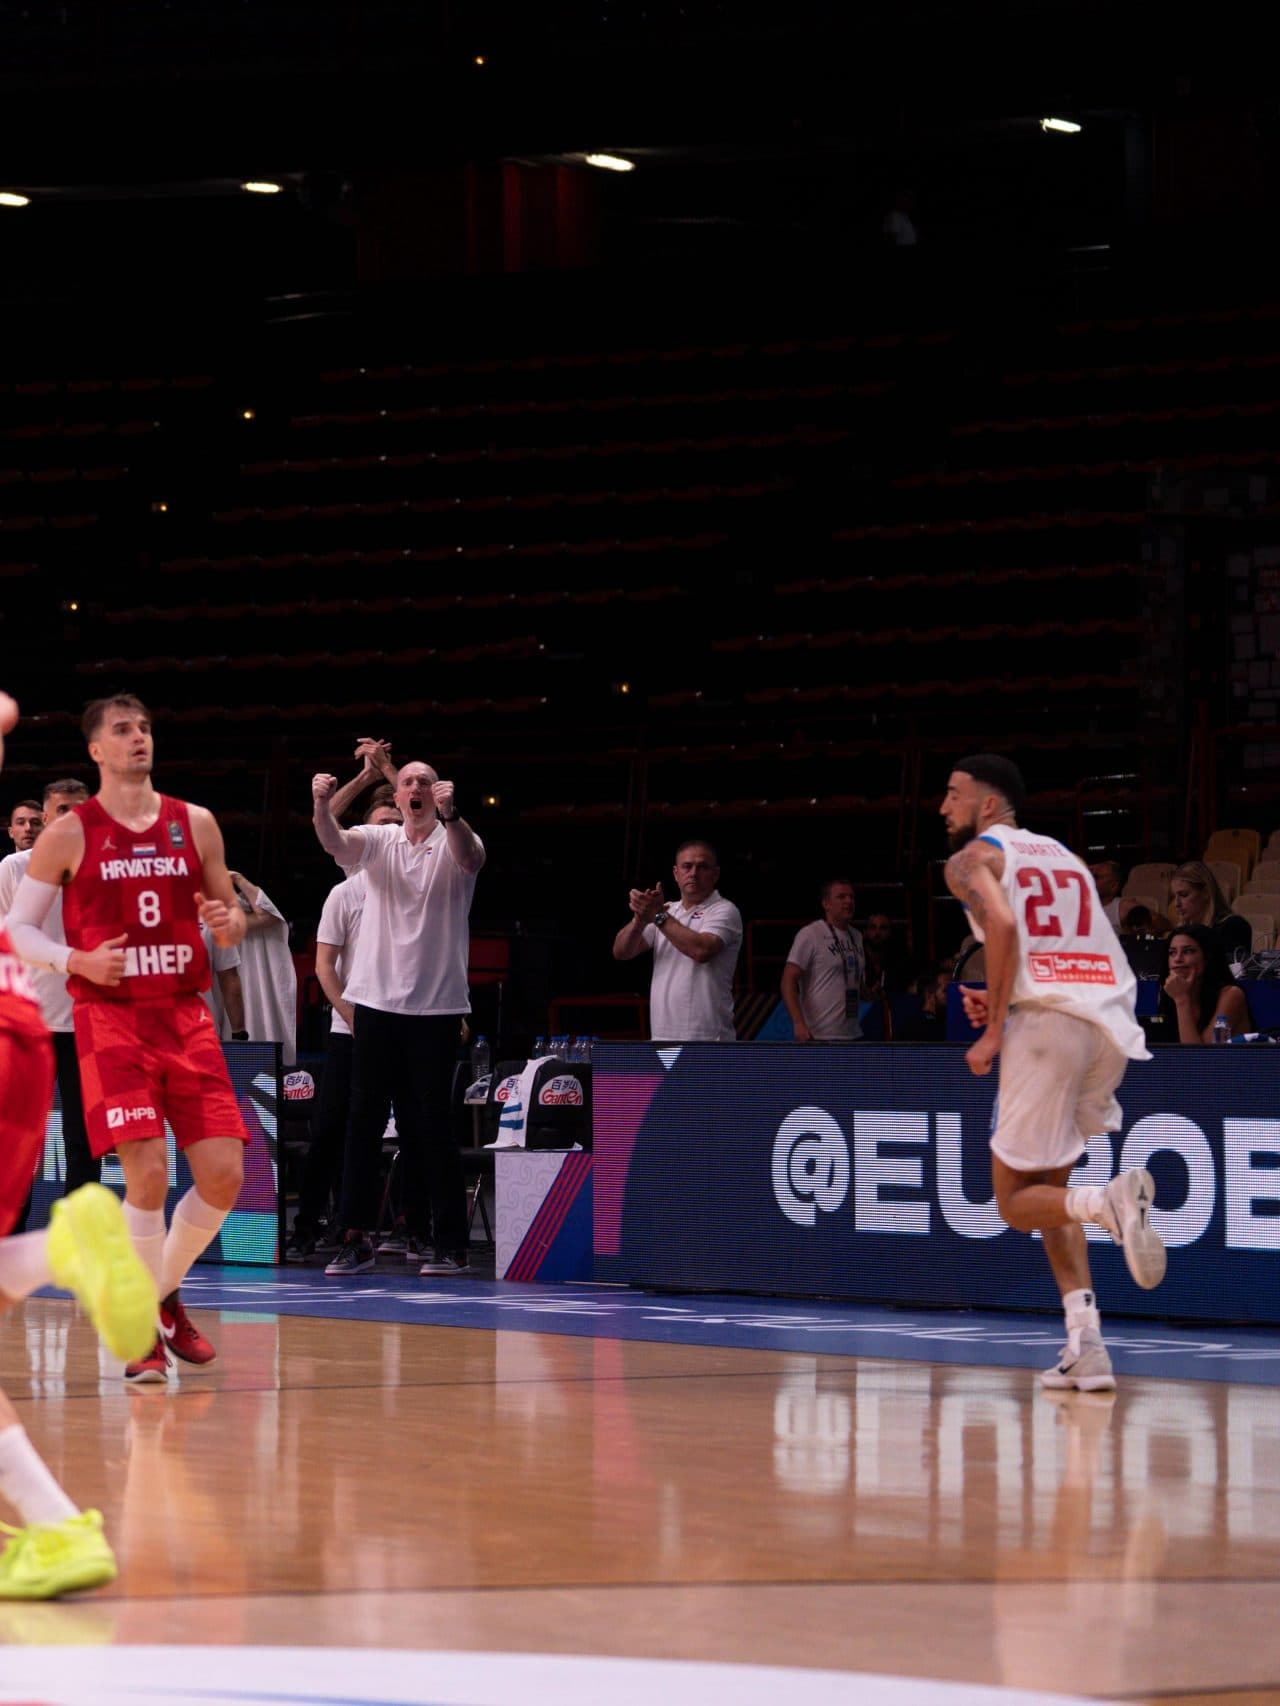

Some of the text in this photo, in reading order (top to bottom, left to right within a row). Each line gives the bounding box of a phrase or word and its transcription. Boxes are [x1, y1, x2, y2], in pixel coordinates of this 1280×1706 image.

[100, 857, 189, 881] HRVATSKA
[137, 890, 162, 929] 8
[1016, 867, 1092, 937] 27
[138, 944, 194, 976] HEP
[124, 1106, 157, 1122] HPB
